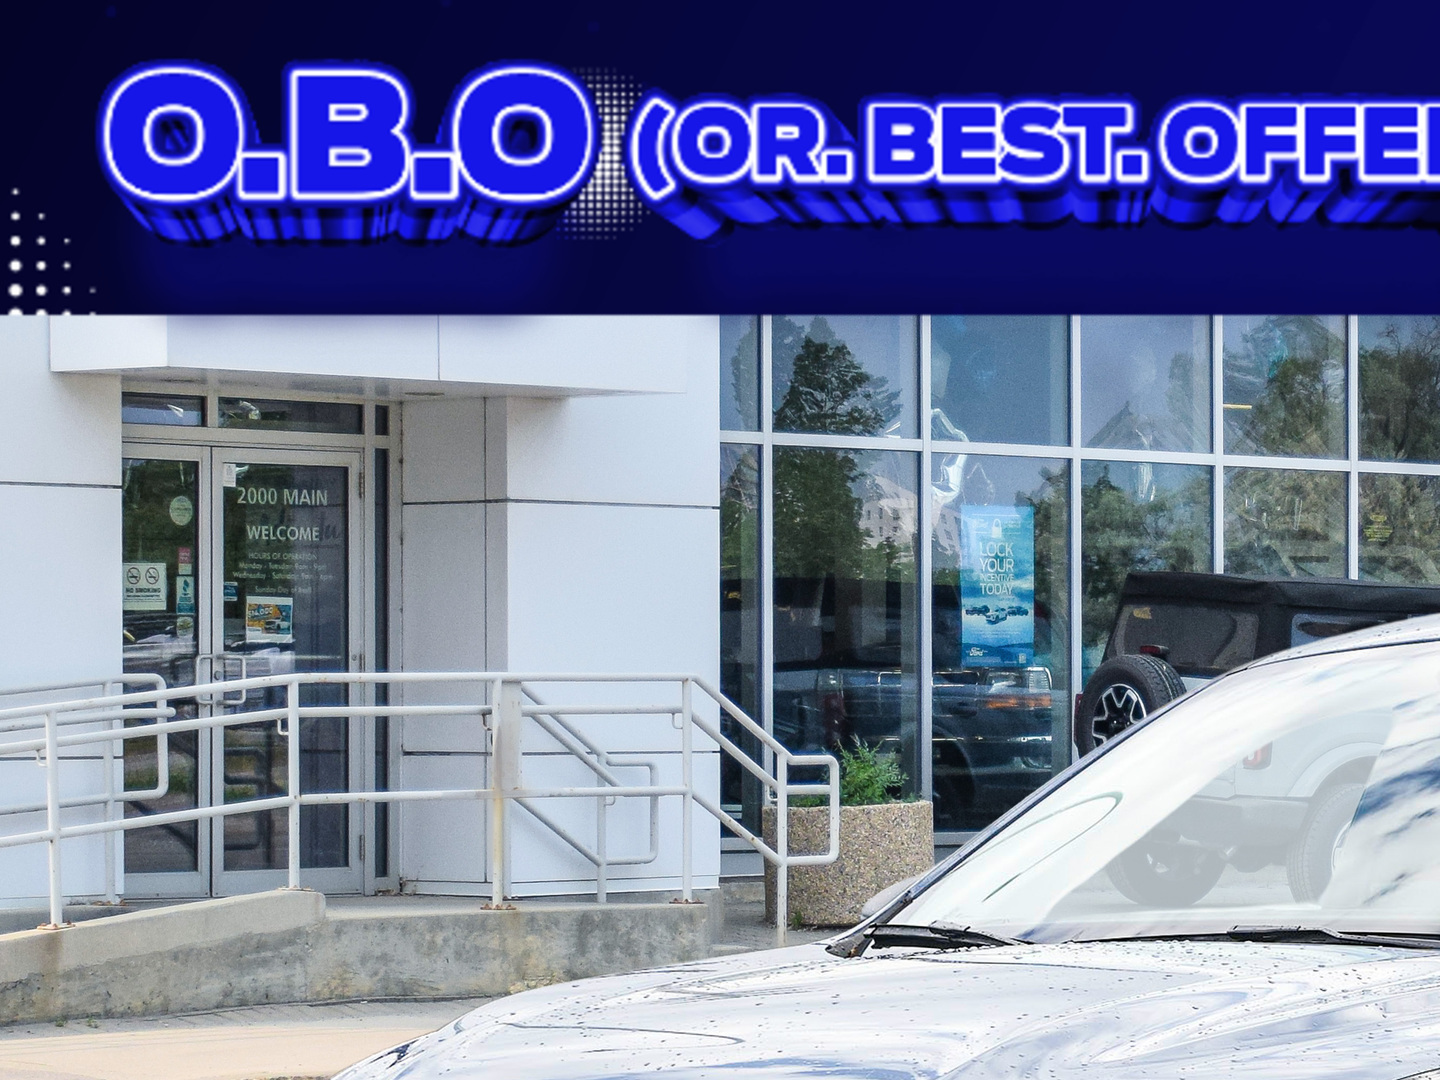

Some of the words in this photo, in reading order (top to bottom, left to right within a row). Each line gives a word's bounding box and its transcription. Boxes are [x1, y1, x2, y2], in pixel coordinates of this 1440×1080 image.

[237, 487, 277, 504] 2000
[283, 488, 328, 506] MAIN
[246, 524, 319, 541] WELCOME
[980, 541, 1014, 556] LOCK
[980, 558, 1014, 572] YOUR
[980, 583, 1013, 595] TODAY
